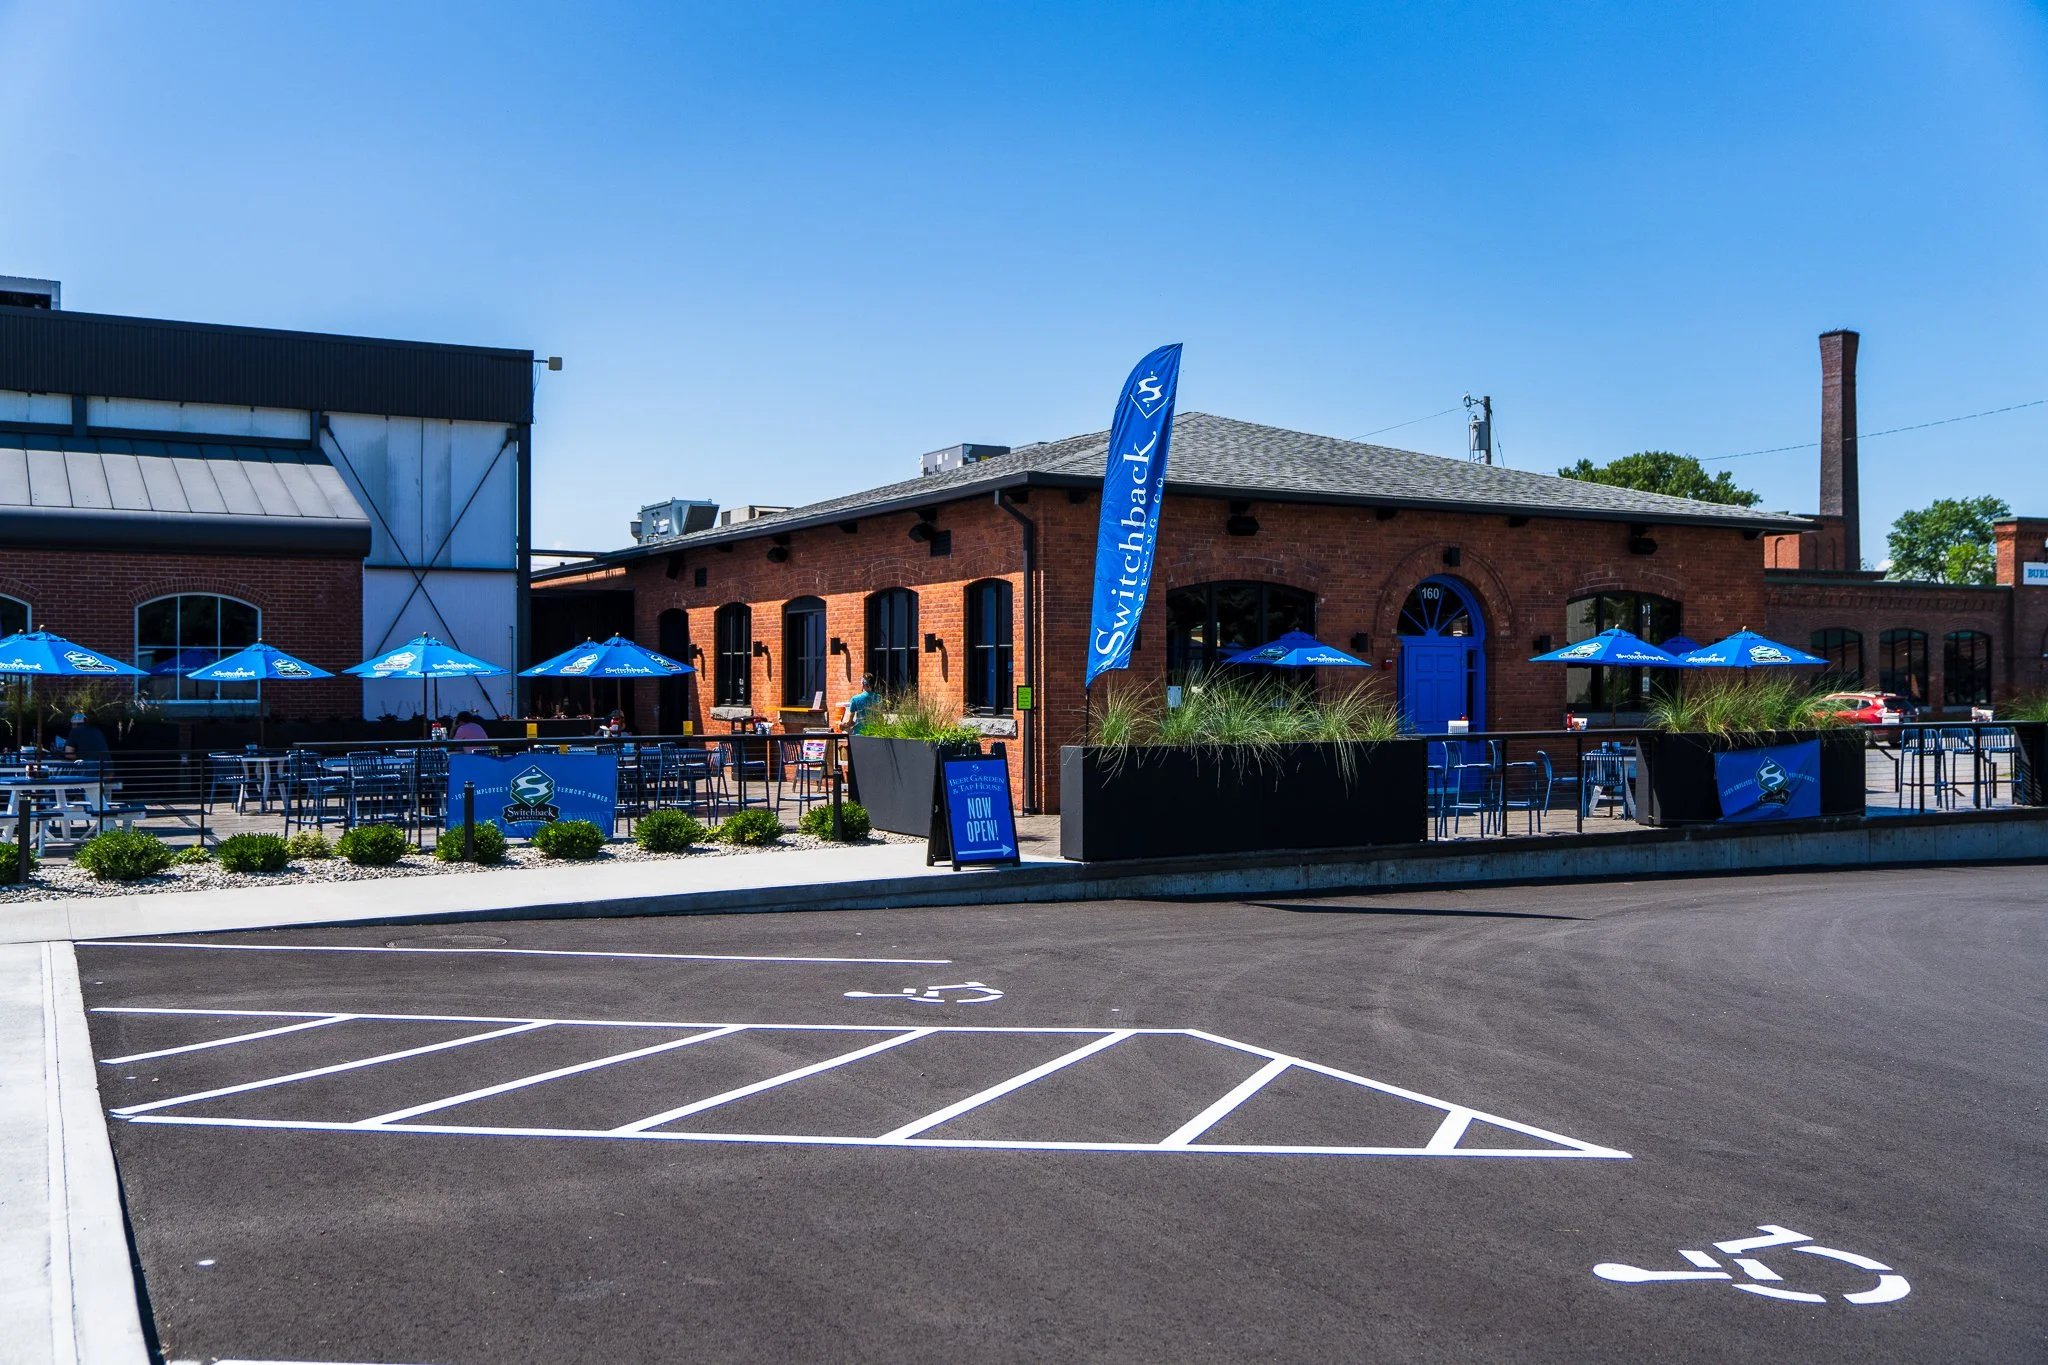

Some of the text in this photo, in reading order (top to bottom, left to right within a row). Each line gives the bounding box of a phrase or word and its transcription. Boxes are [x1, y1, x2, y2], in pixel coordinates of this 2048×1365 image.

[1095, 430, 1157, 671] Switchback
[1421, 587, 1440, 600] 160
[949, 775, 1005, 786] BEER GARDEN
[474, 786, 504, 798] MPLOYEE
[557, 786, 586, 797] VERMONT
[958, 784, 975, 793] TAP
[975, 783, 1002, 792] HOUSE
[507, 806, 556, 818] Switchback
[967, 796, 992, 820] NOW
[966, 820, 999, 843] OPEN!
